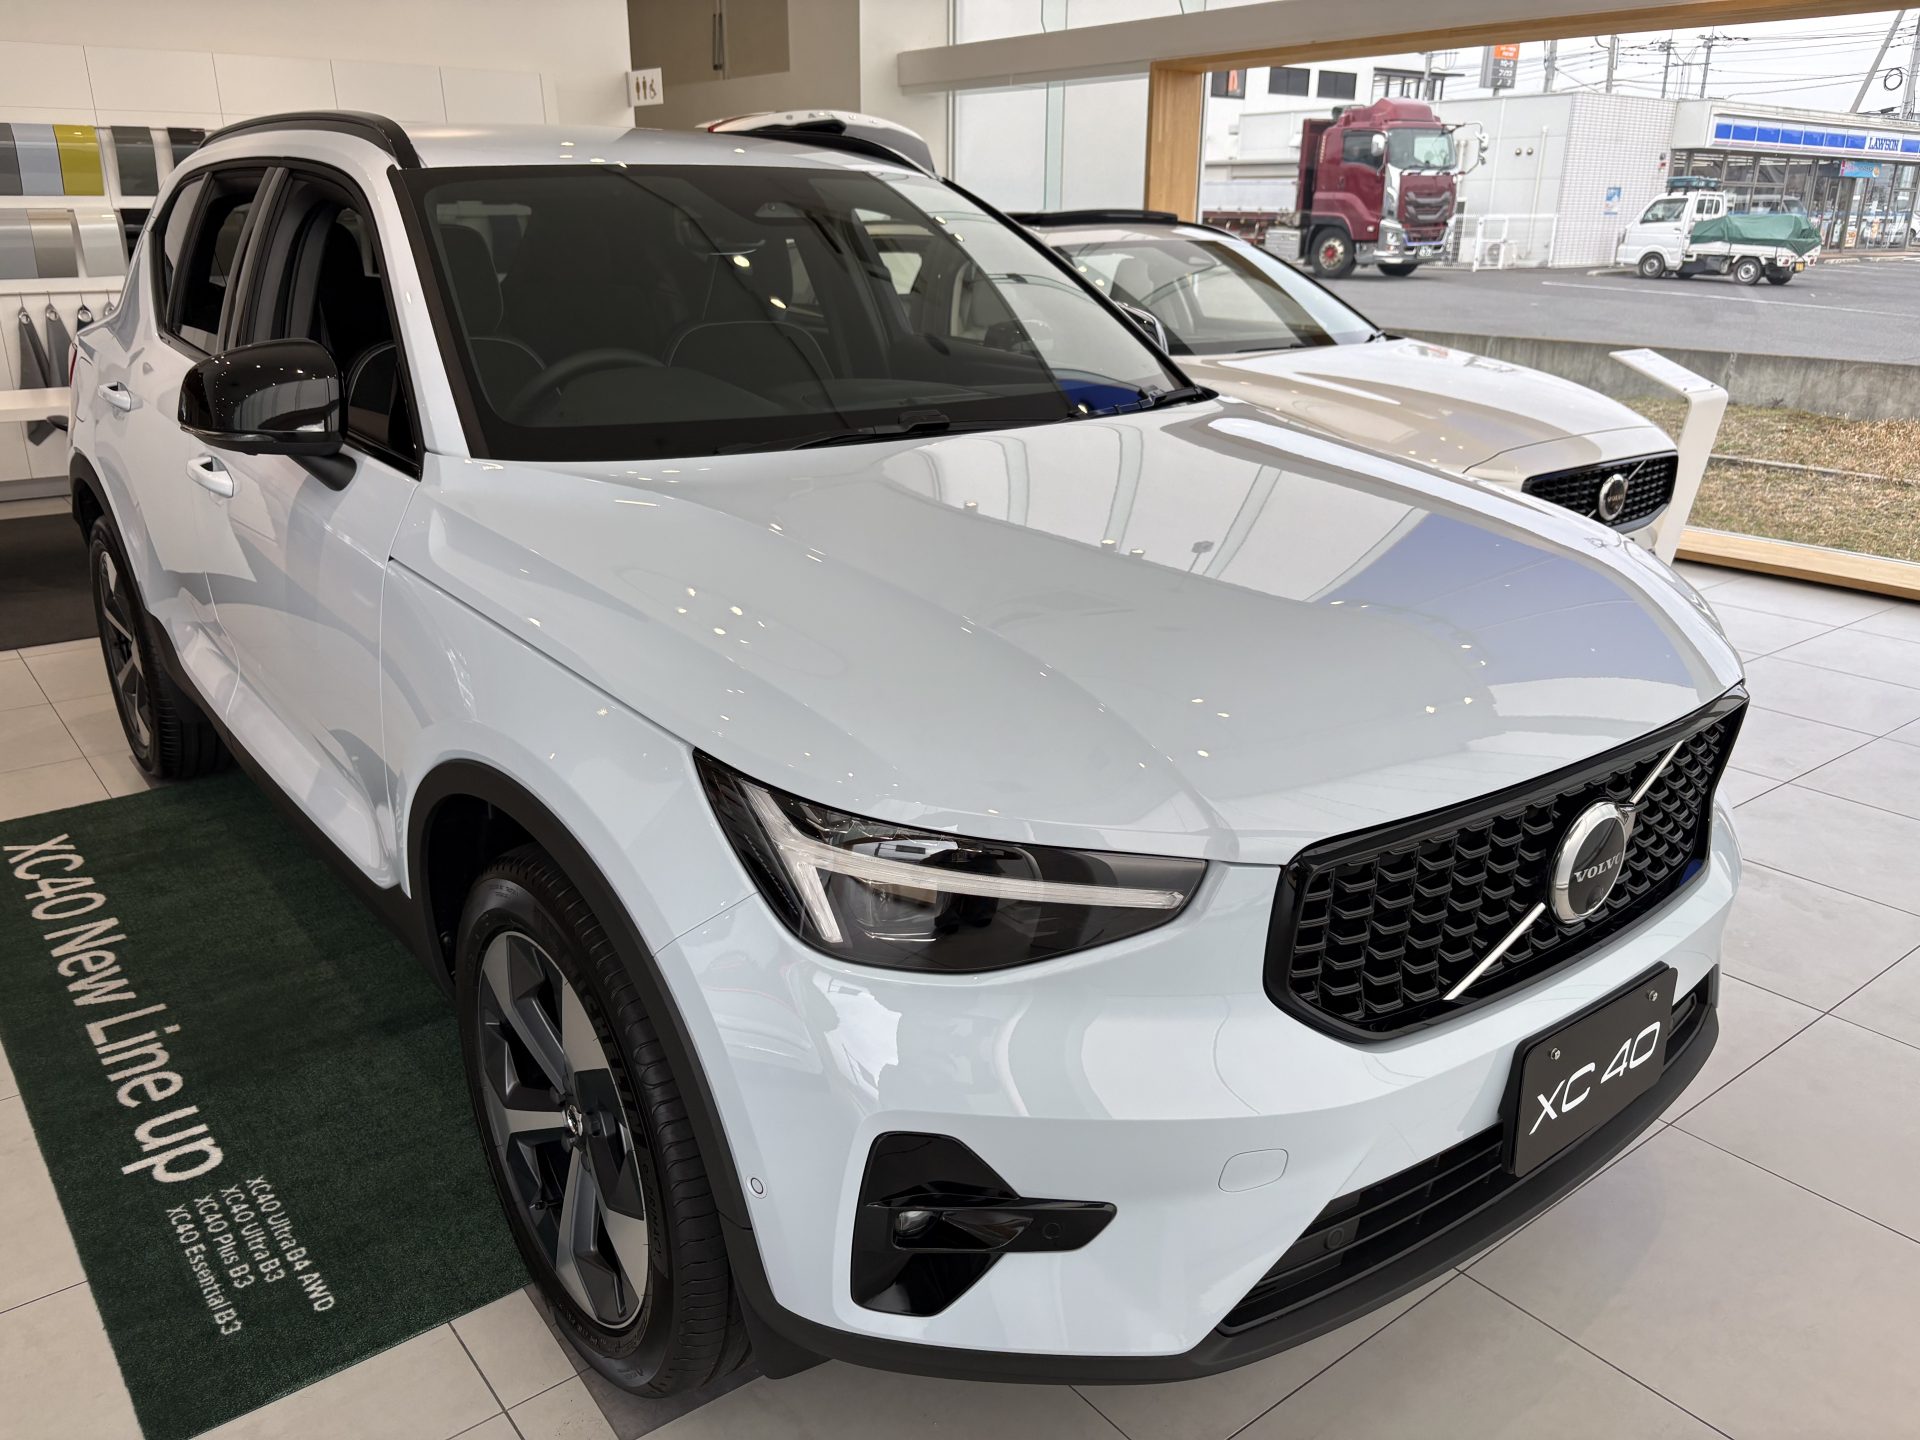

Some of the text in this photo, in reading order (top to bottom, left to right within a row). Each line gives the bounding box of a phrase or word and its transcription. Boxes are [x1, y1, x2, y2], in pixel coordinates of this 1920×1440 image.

[1868, 136, 1900, 151] LAWSON
[1573, 852, 1623, 883] VOLVO
[3, 833, 224, 1183] XC40 New Line up
[1529, 1021, 1661, 1136] XC 40
[166, 1204, 242, 1336] XC40 Essential B3
[194, 1193, 256, 1289] XC40 Plus B3
[220, 1184, 286, 1283] XC40 Ultra B3
[246, 1174, 335, 1312] XC40 Ultra B4 AWD
